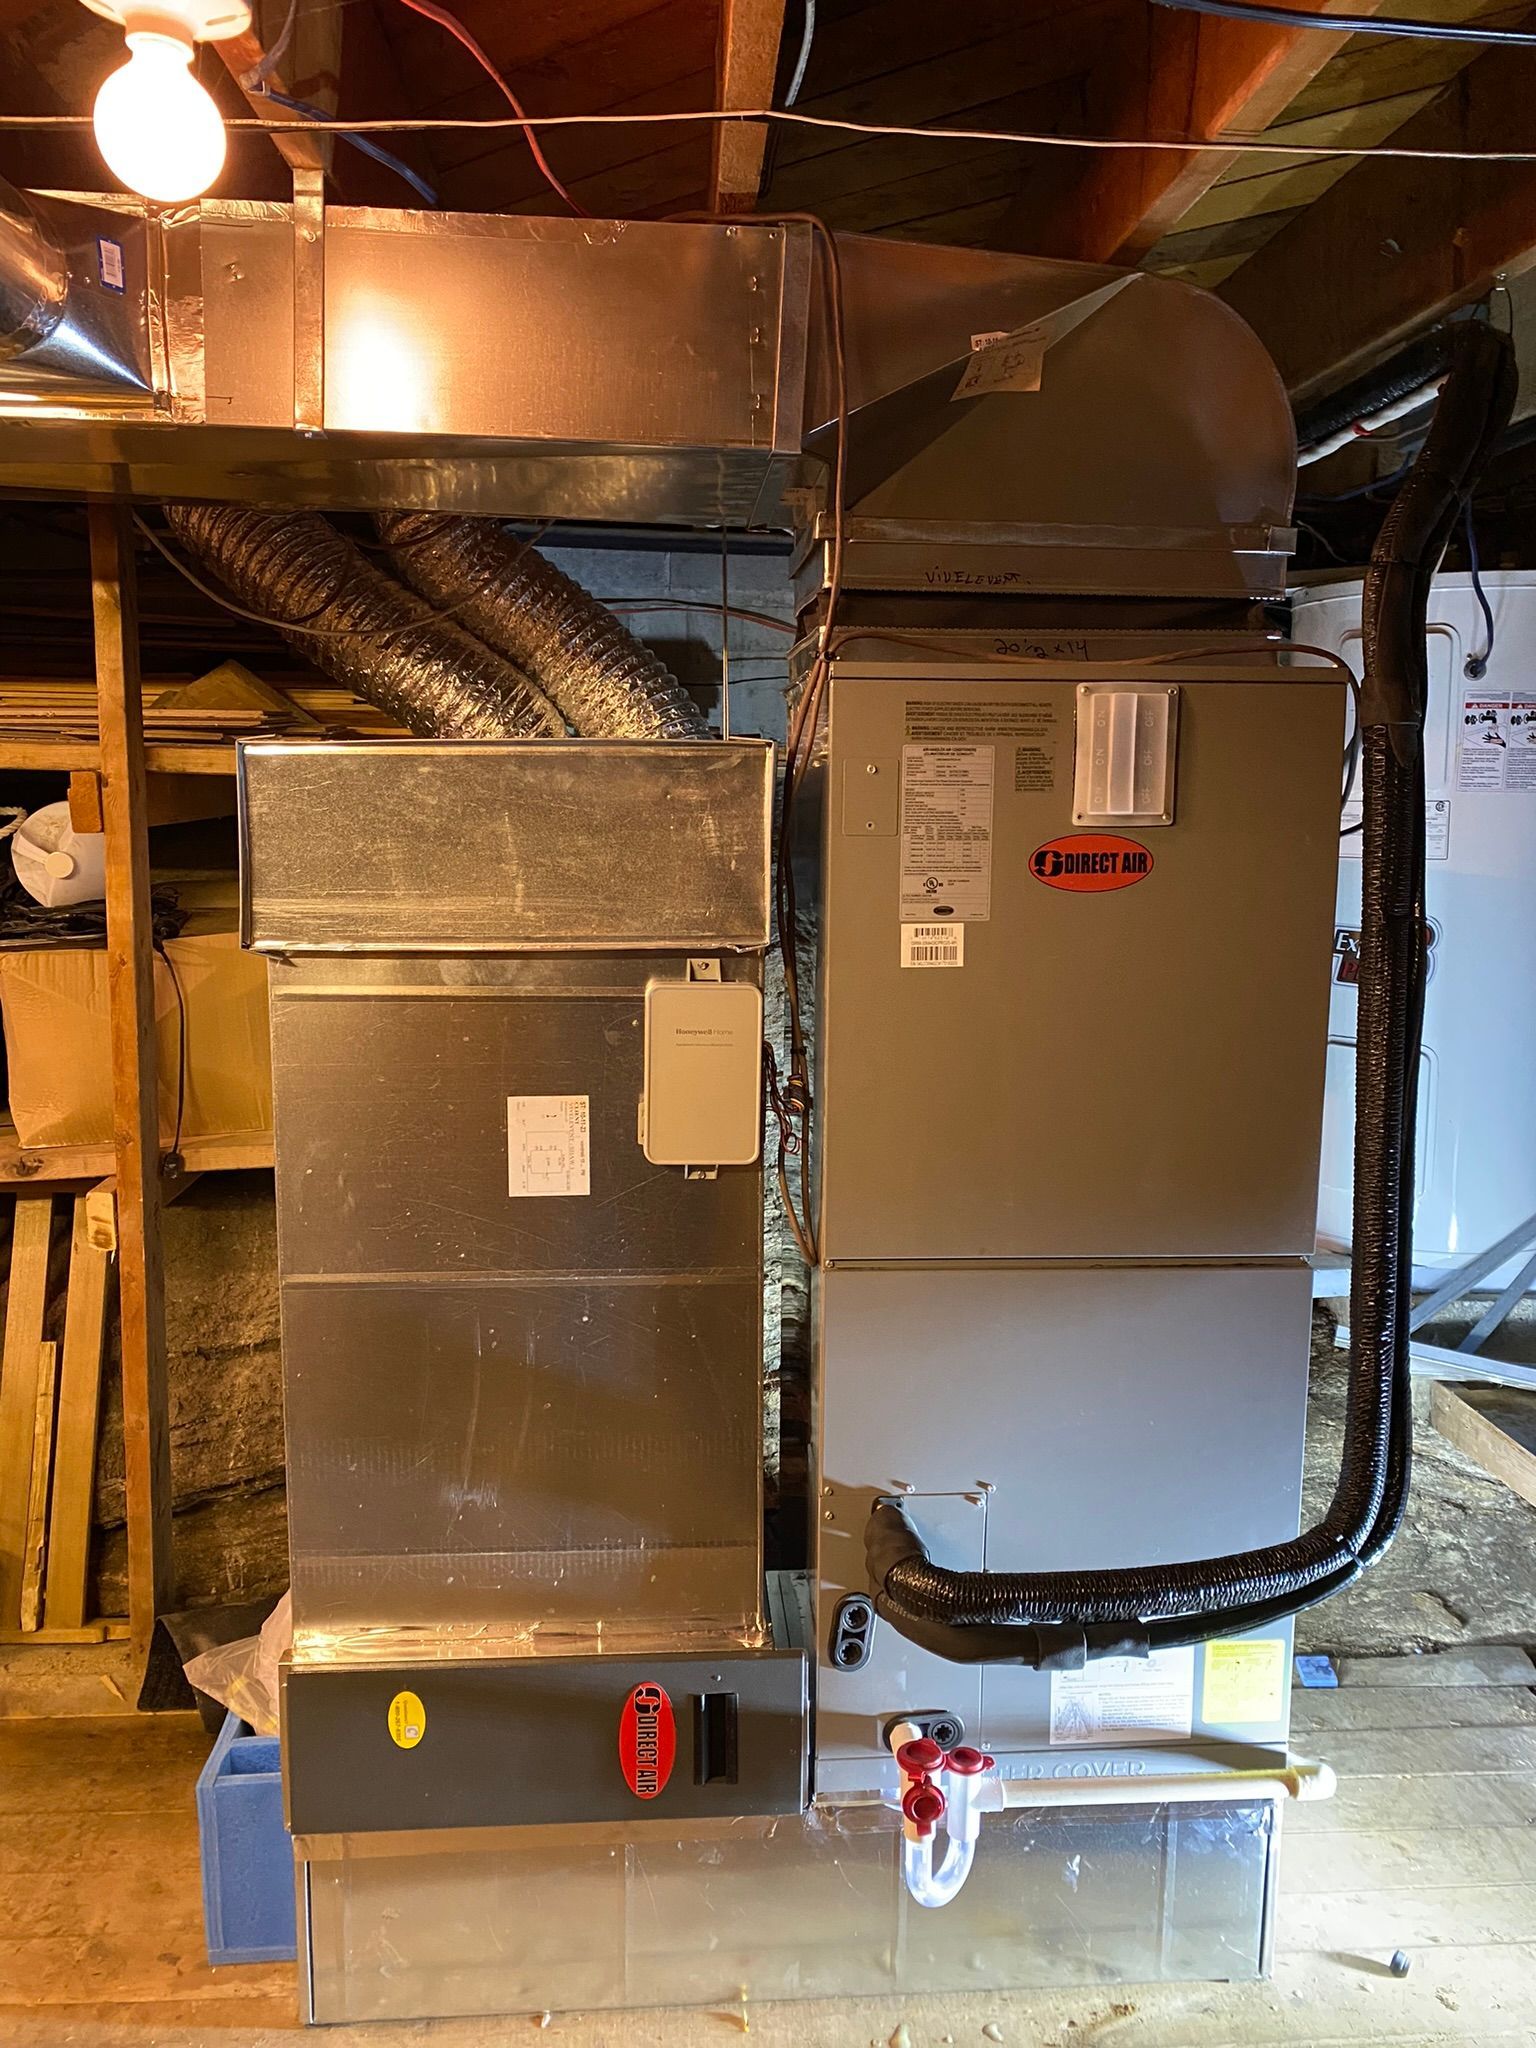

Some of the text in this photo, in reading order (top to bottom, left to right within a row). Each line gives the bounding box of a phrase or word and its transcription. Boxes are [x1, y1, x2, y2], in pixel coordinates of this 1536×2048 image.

[1095, 749, 1105, 766] ON
[1143, 750, 1153, 766] OFF
[1064, 852, 1147, 874] DIRECT AIR
[637, 1715, 658, 1793] DIRECT AIR
[1053, 1761, 1146, 1778] COVER
